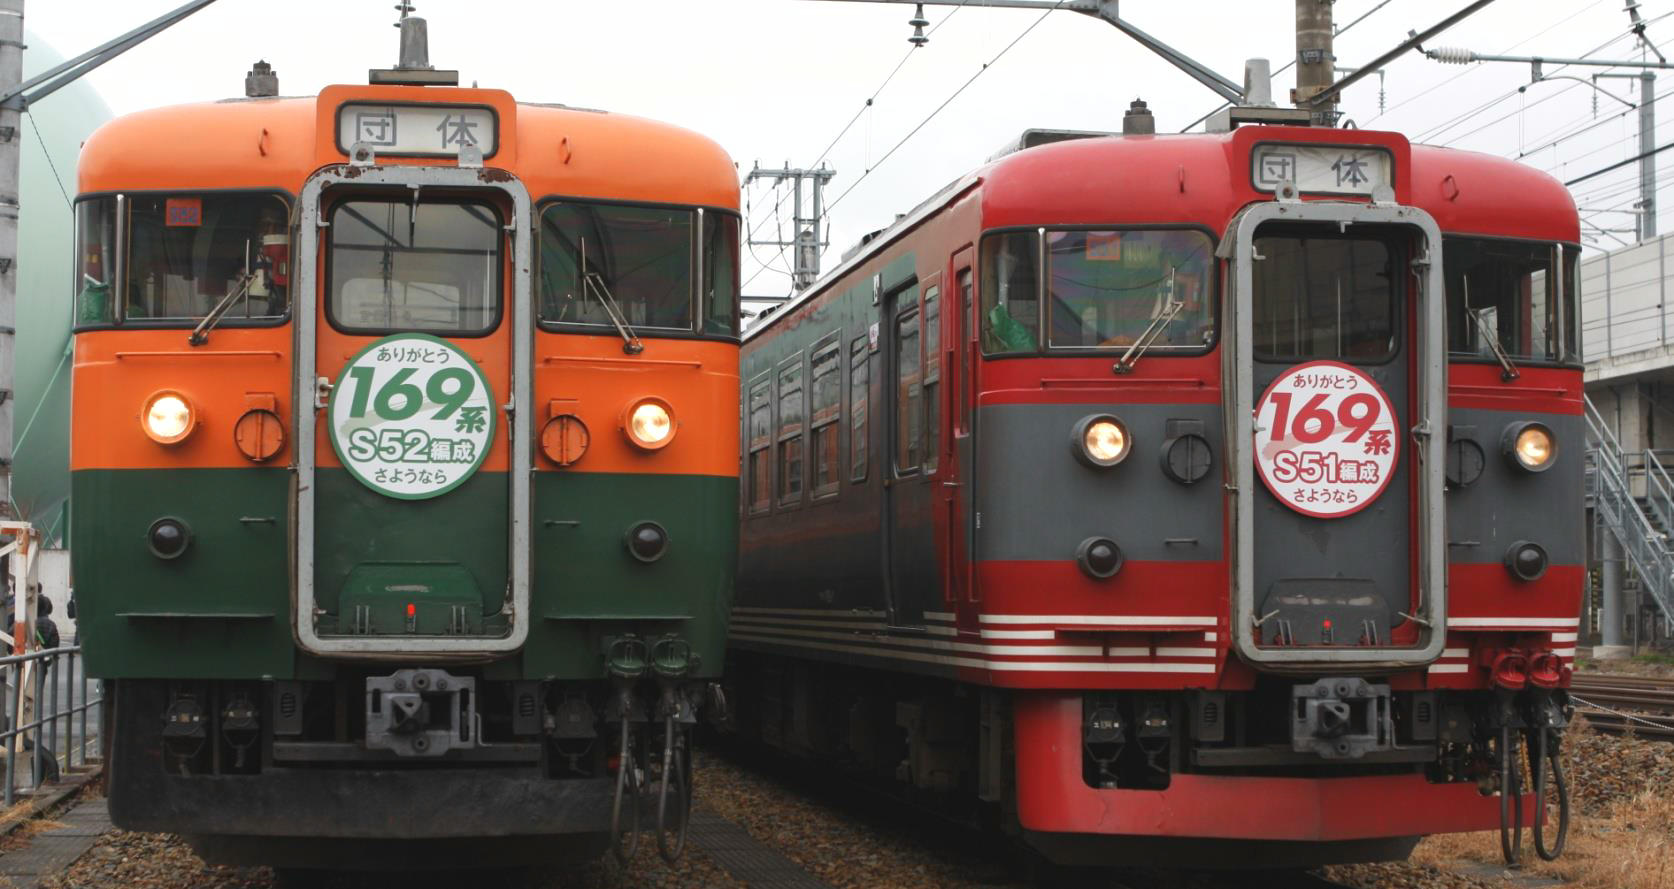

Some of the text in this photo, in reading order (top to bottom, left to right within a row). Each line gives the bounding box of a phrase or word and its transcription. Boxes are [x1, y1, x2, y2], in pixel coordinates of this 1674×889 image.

[356, 112, 478, 149] 団体
[1260, 152, 1368, 188] 団体
[377, 347, 449, 364] ありがとう
[1293, 374, 1358, 389] ありがとう
[349, 366, 488, 434] 169系
[1270, 392, 1393, 455] 169系
[348, 427, 476, 464] S52編成
[374, 468, 447, 484] さようなら
[1273, 449, 1380, 484] S51編成
[1293, 488, 1358, 503] さようなら
